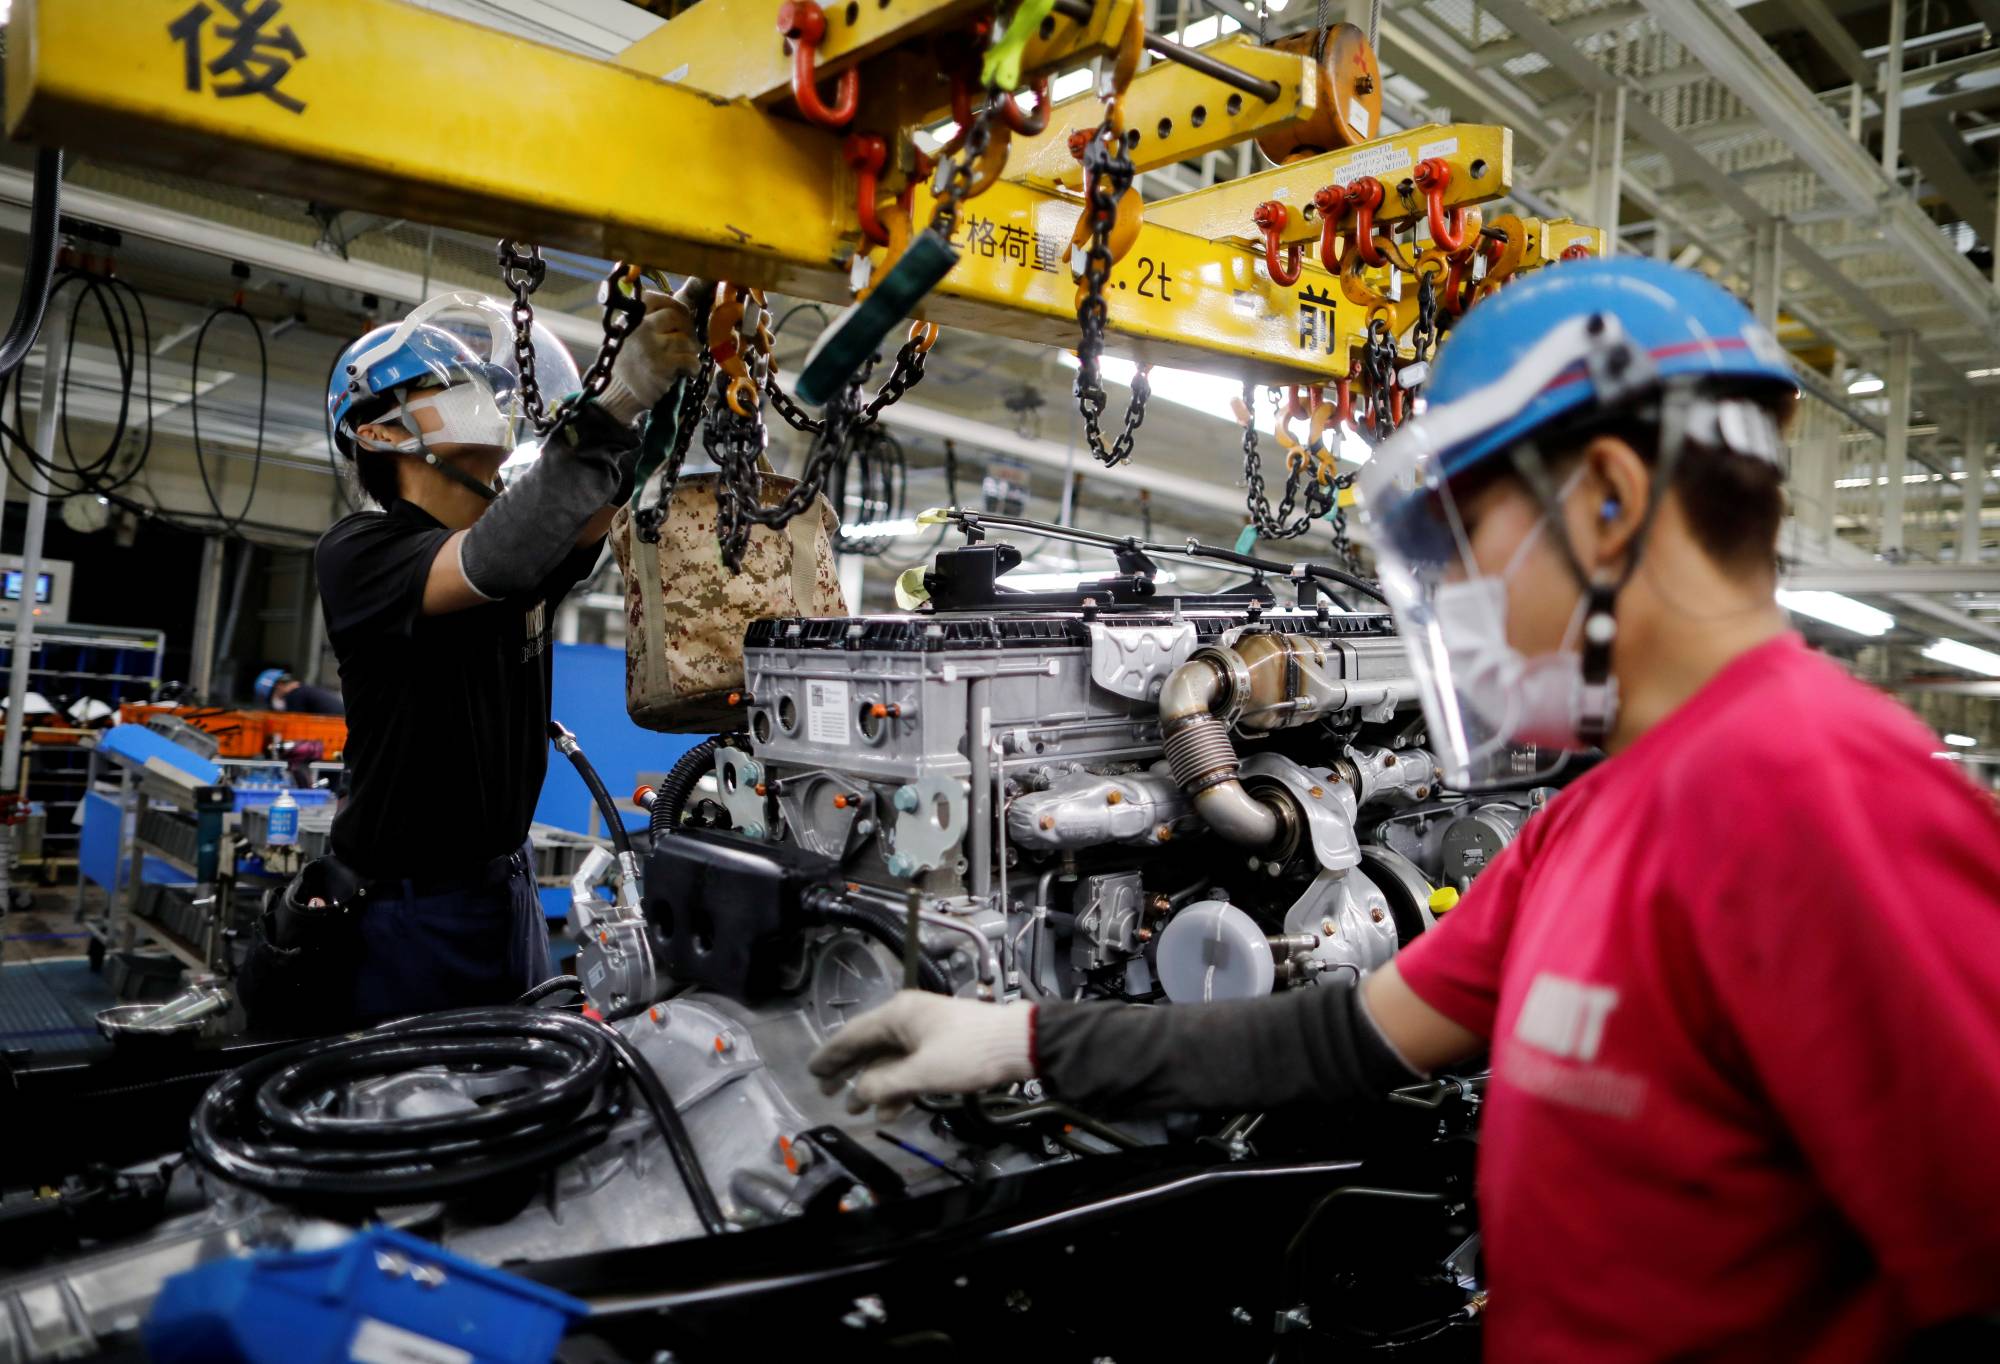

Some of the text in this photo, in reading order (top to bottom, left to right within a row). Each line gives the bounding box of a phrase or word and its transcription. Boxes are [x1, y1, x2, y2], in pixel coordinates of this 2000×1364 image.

[167, 0, 307, 115] 後
[1110, 256, 1172, 302] .2t
[1298, 284, 1337, 355] 前
